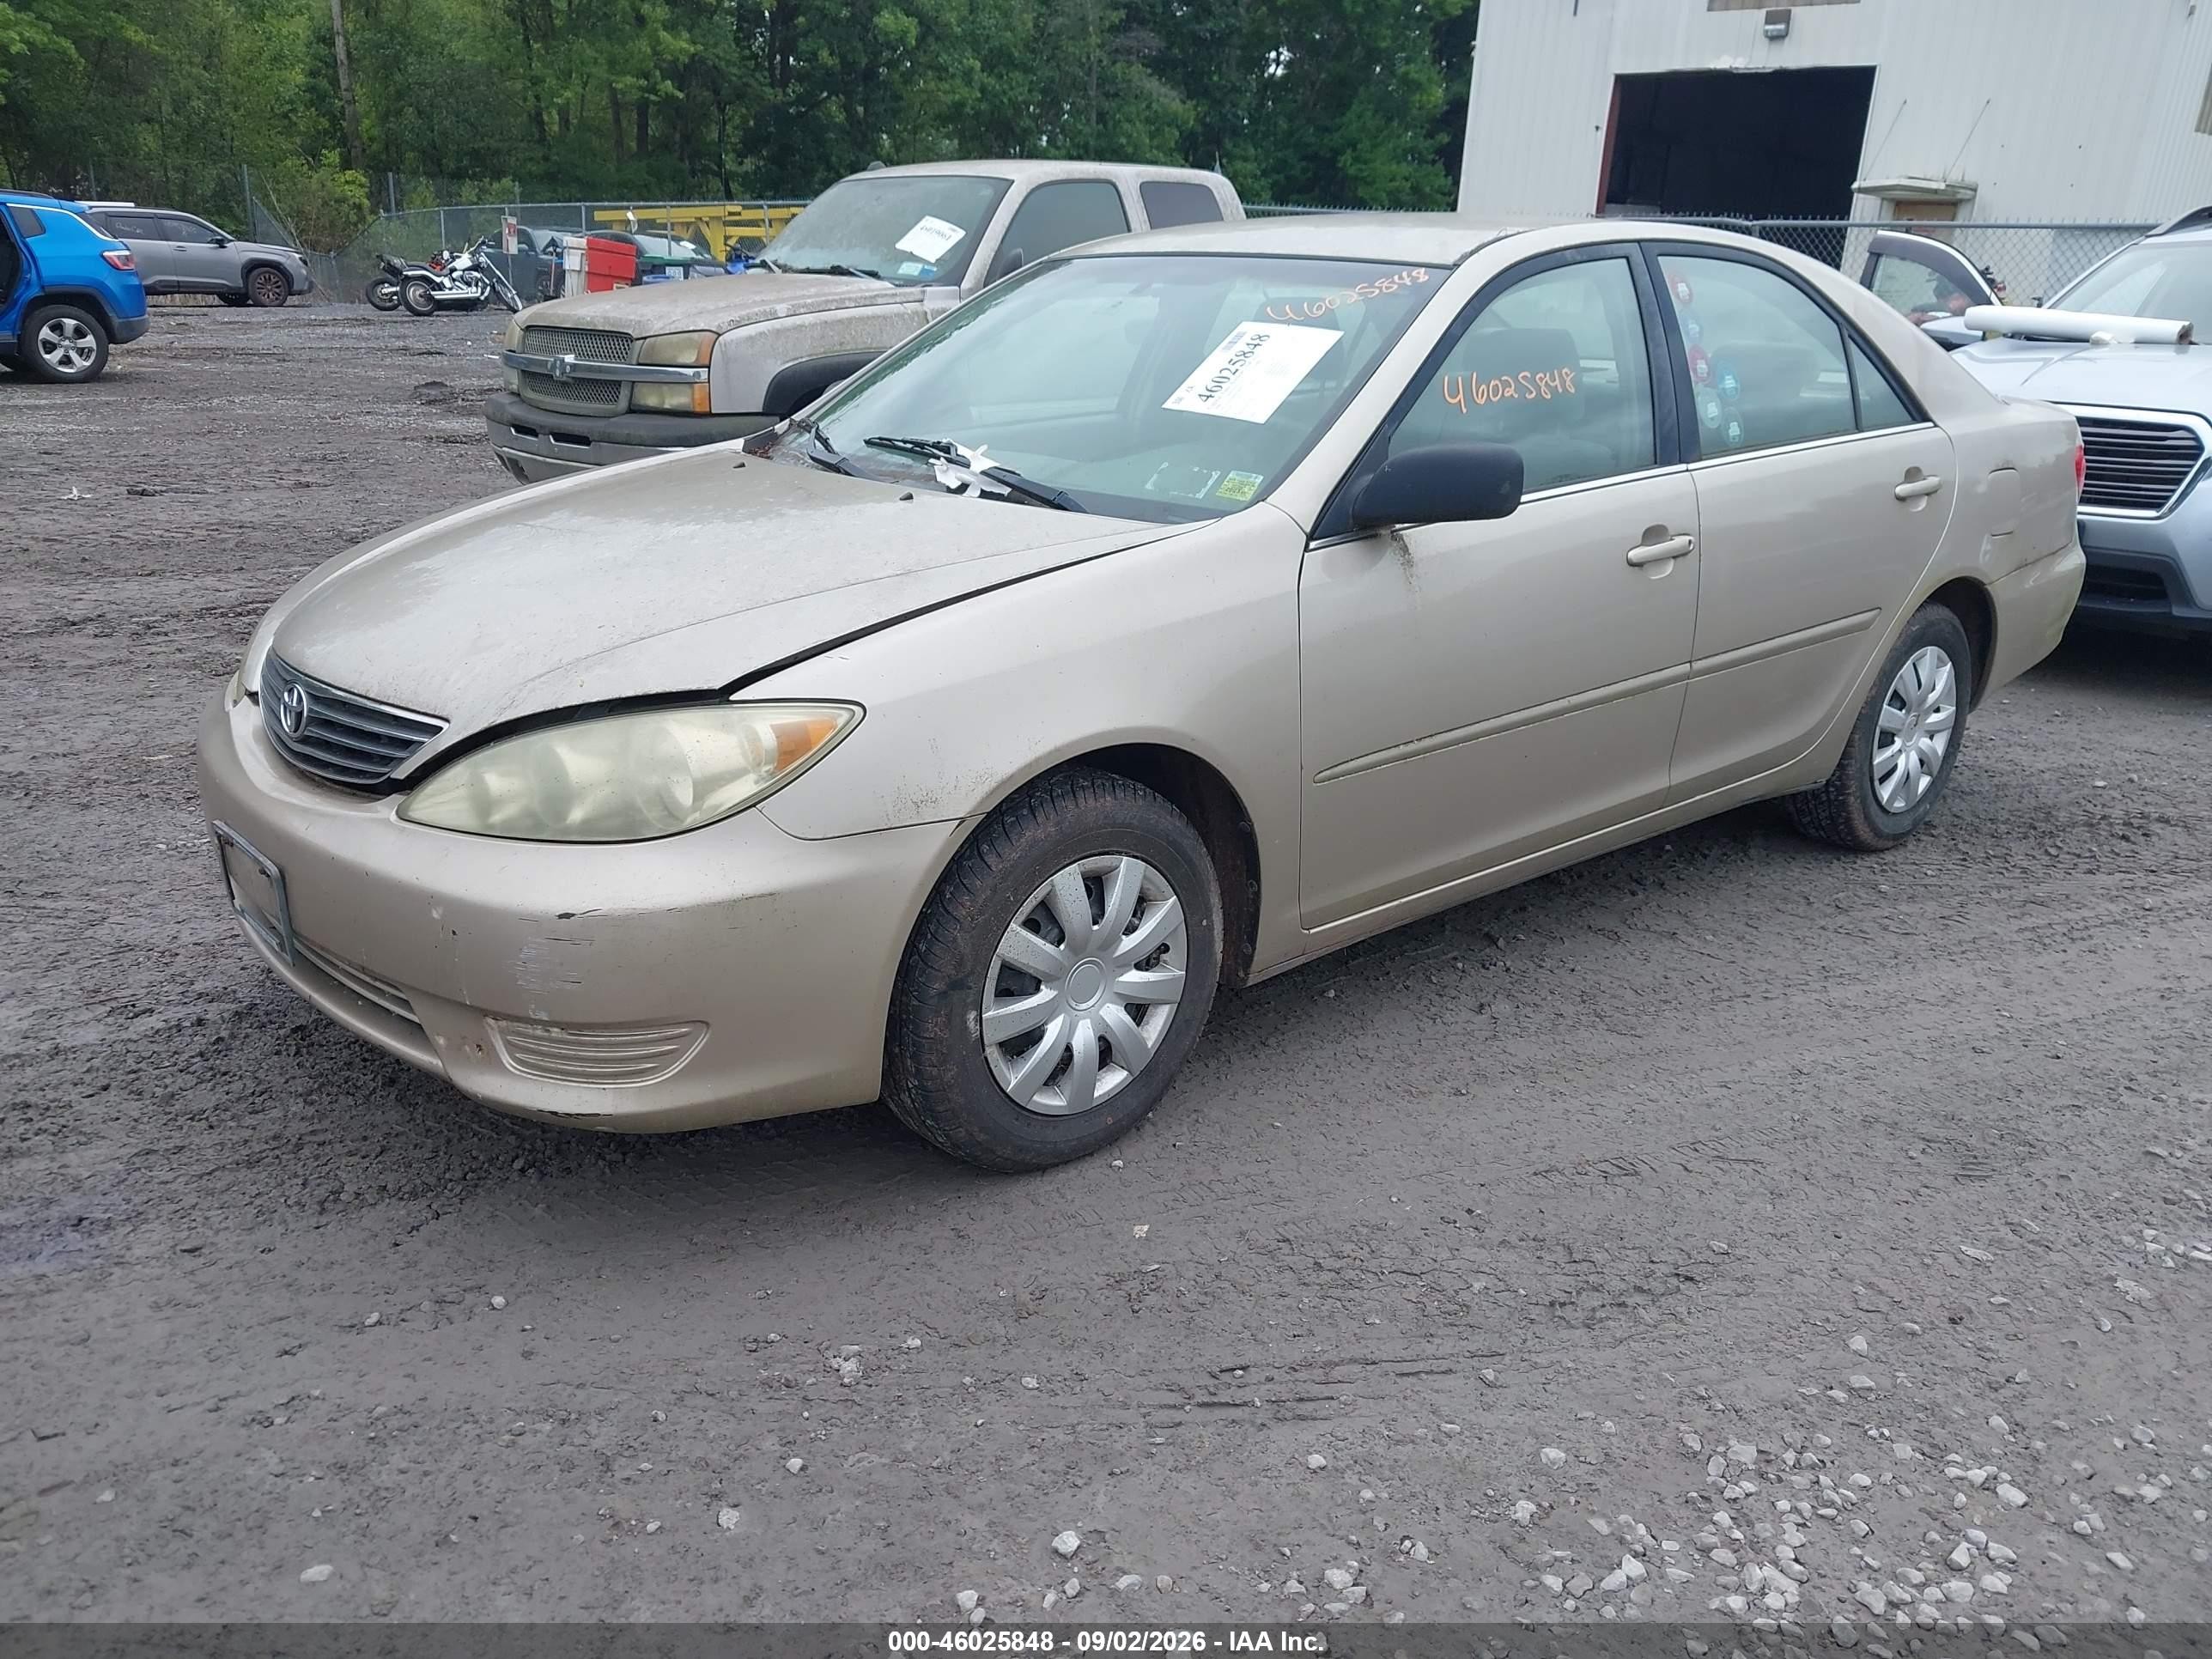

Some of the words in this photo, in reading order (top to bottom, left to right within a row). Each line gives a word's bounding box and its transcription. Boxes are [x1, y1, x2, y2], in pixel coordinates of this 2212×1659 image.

[1267, 268, 1429, 321] 46025848
[1197, 333, 1271, 403] 46025848
[1443, 368, 1576, 414] 46025848
